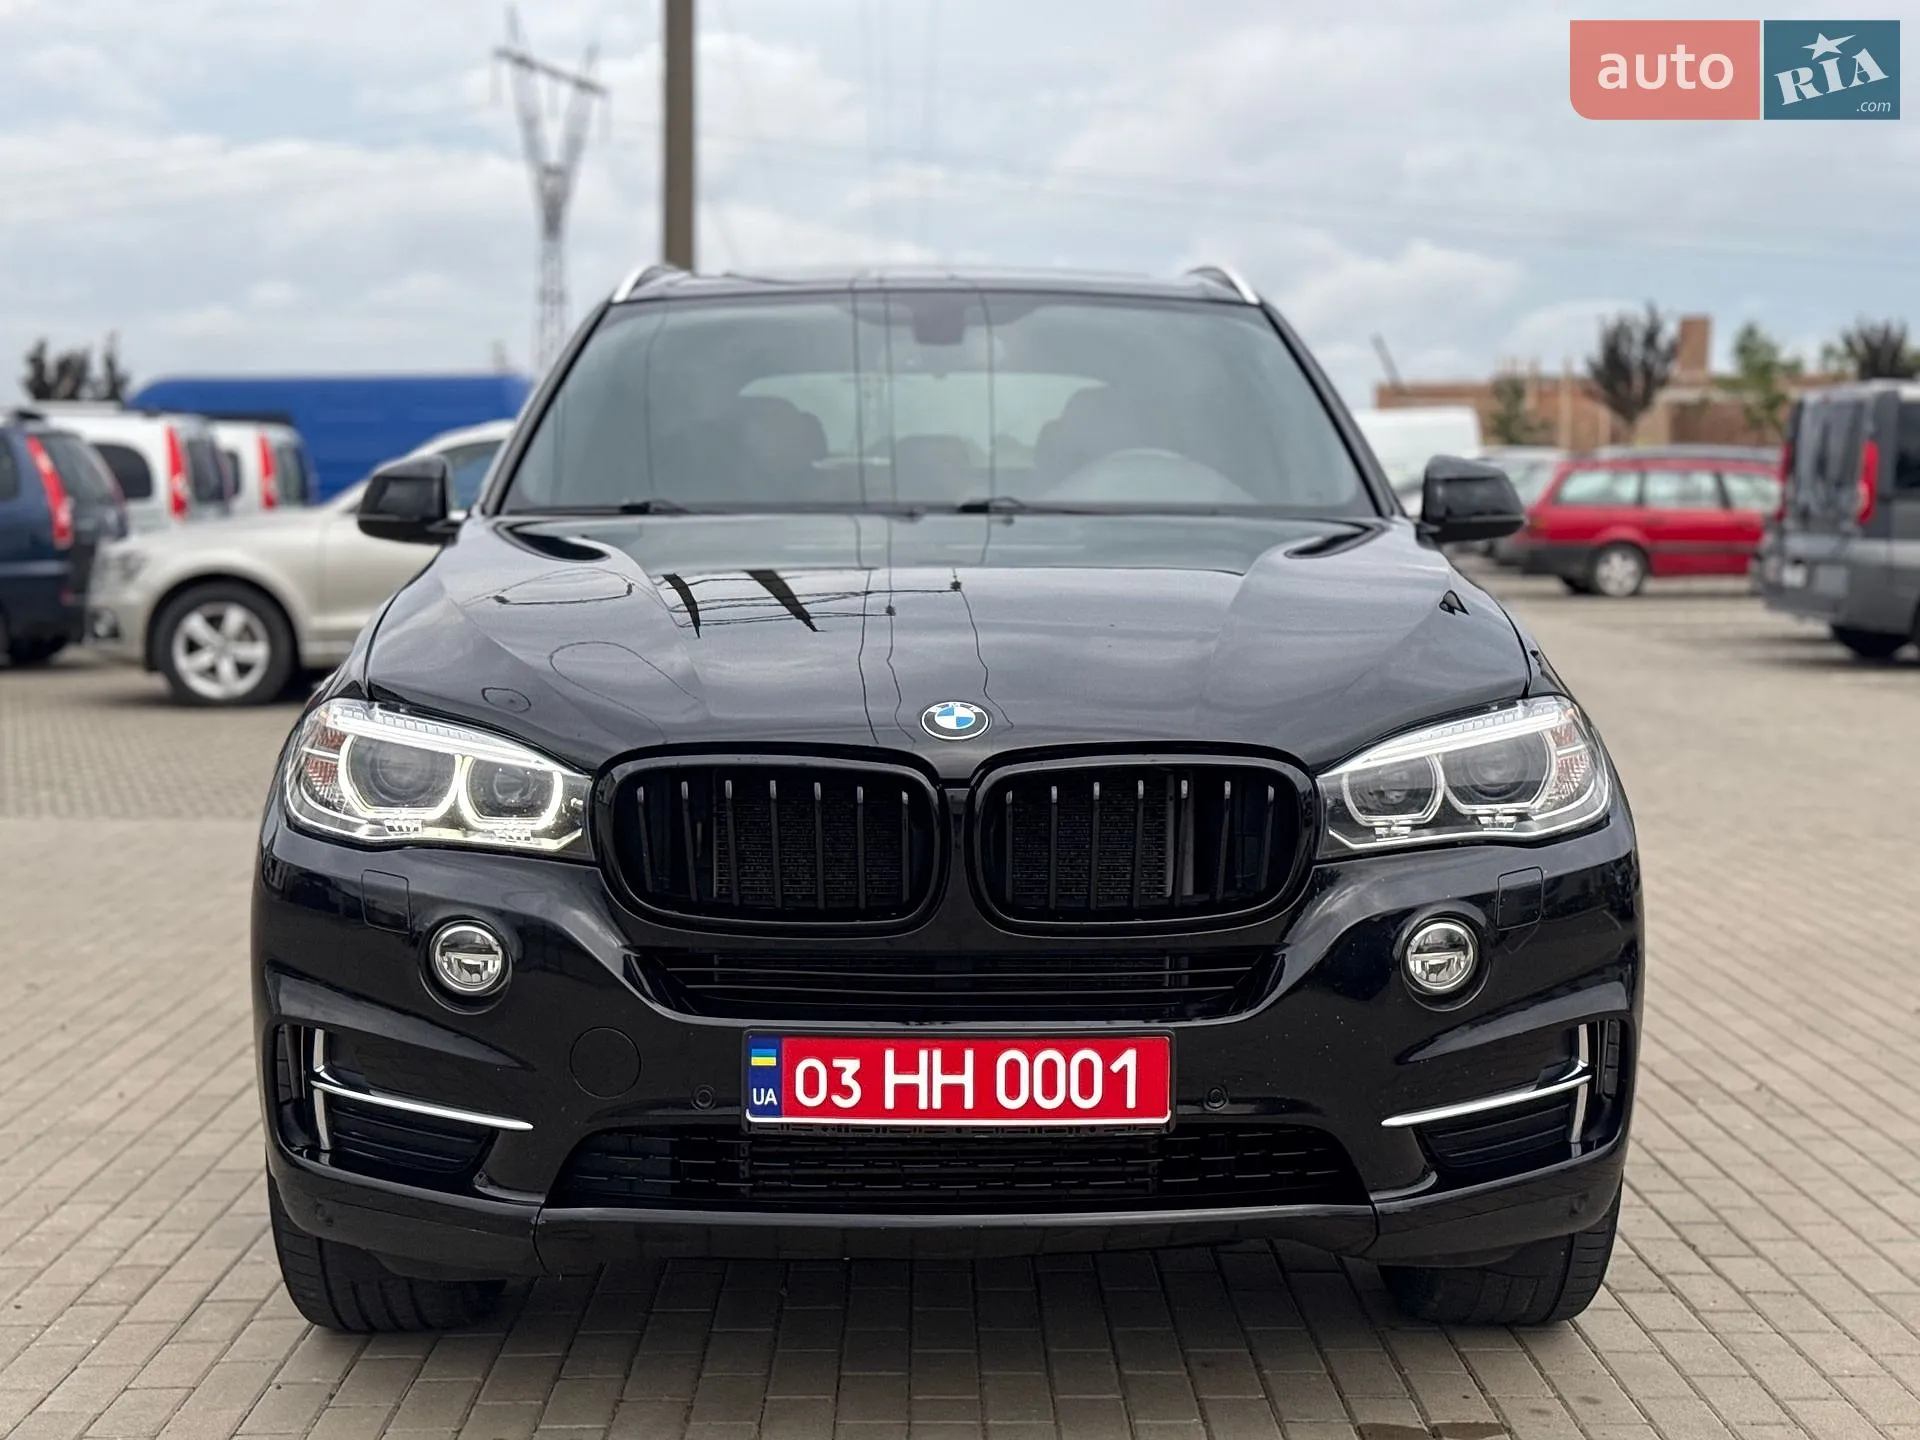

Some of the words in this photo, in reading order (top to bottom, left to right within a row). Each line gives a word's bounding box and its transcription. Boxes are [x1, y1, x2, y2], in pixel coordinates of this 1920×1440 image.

[752, 1087, 778, 1106] UA
[795, 1057, 862, 1109] 03
[884, 1048, 974, 1110] HH
[996, 1048, 1138, 1110] 0001
